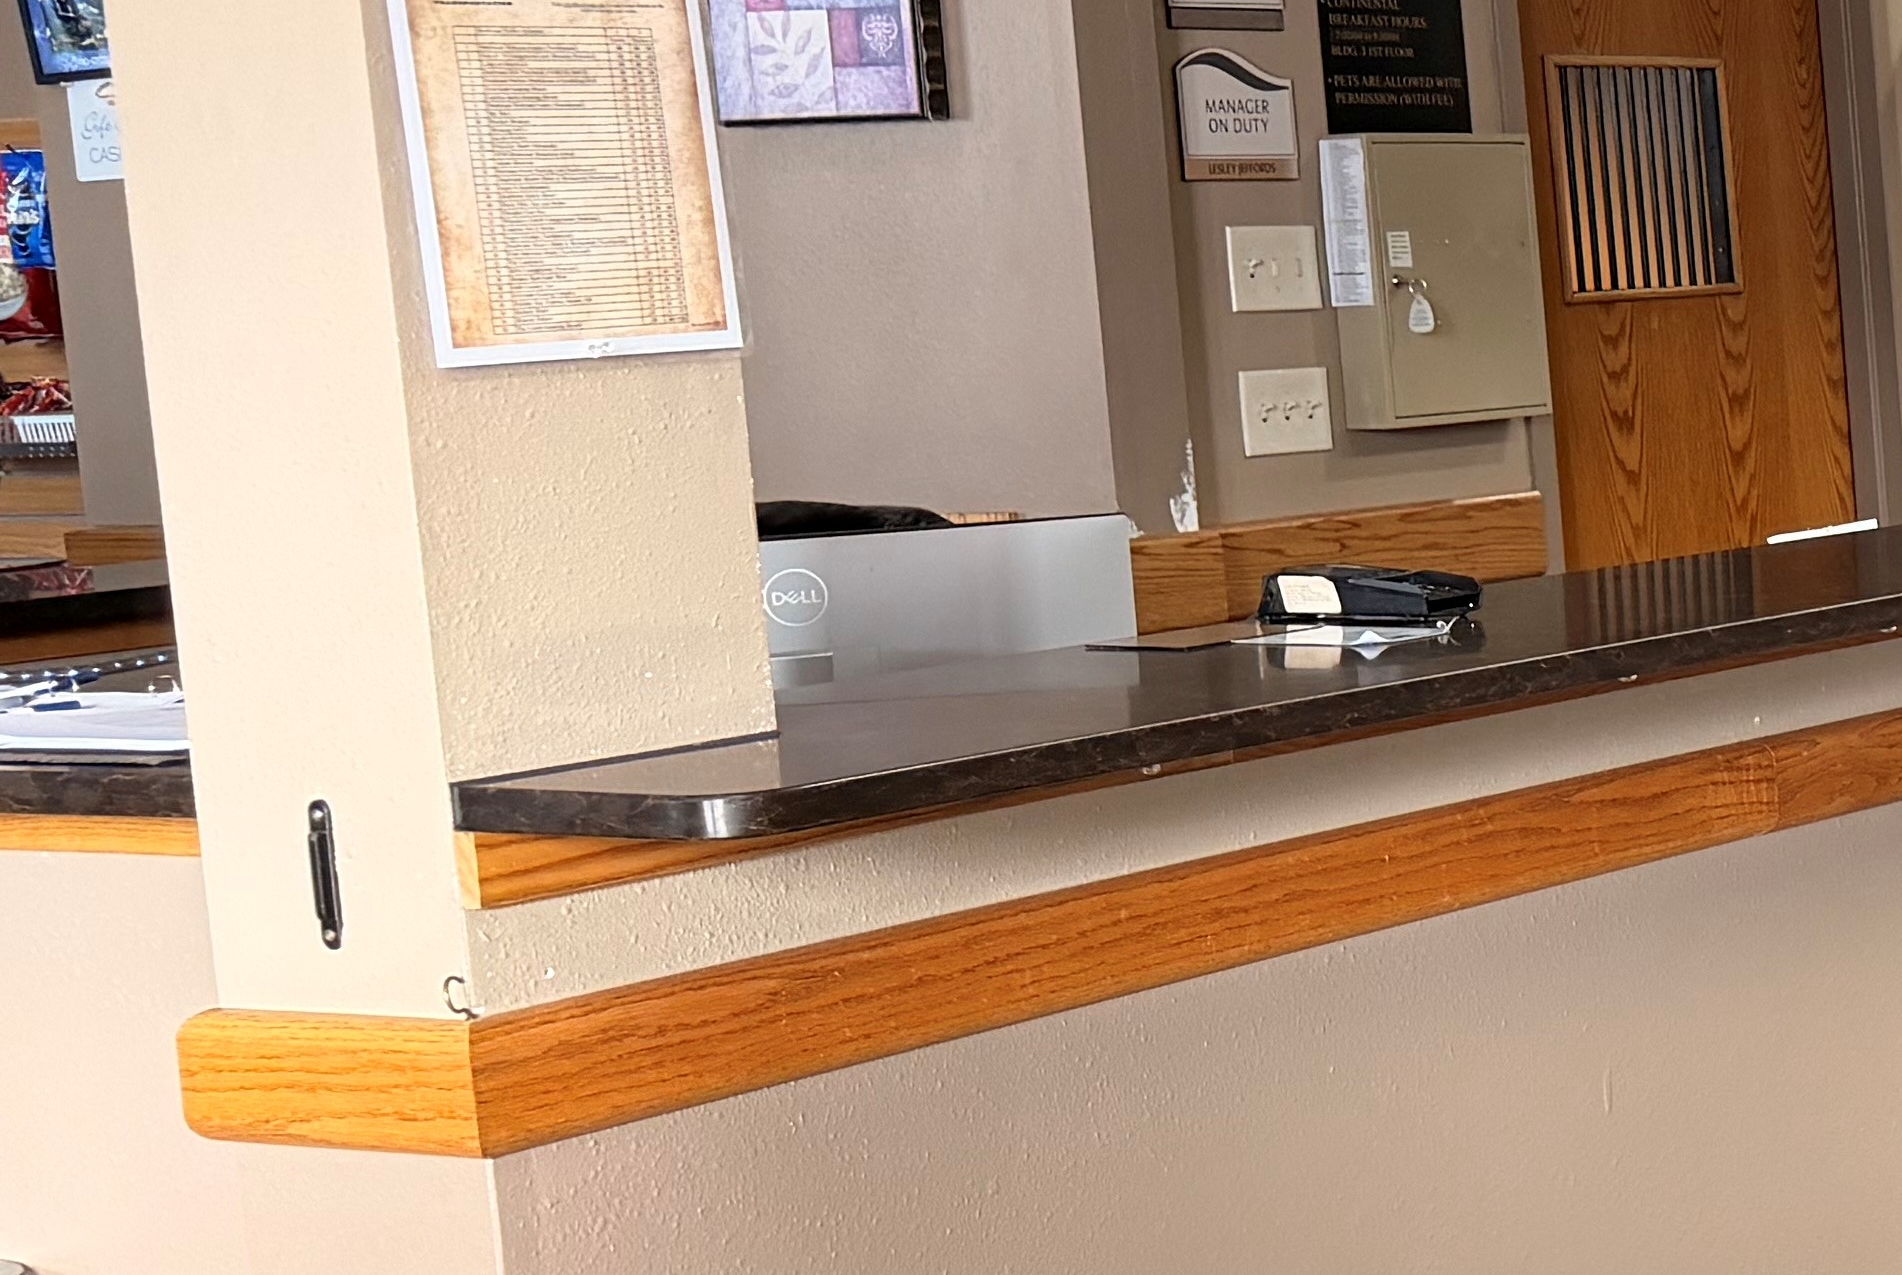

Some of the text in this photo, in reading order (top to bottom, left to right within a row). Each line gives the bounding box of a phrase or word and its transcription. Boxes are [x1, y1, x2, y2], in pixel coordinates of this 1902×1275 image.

[1205, 98, 1270, 115] MANAGER
[1209, 117, 1269, 134] ON DUTY
[90, 147, 121, 163] CAS
[771, 590, 822, 606] DELL
